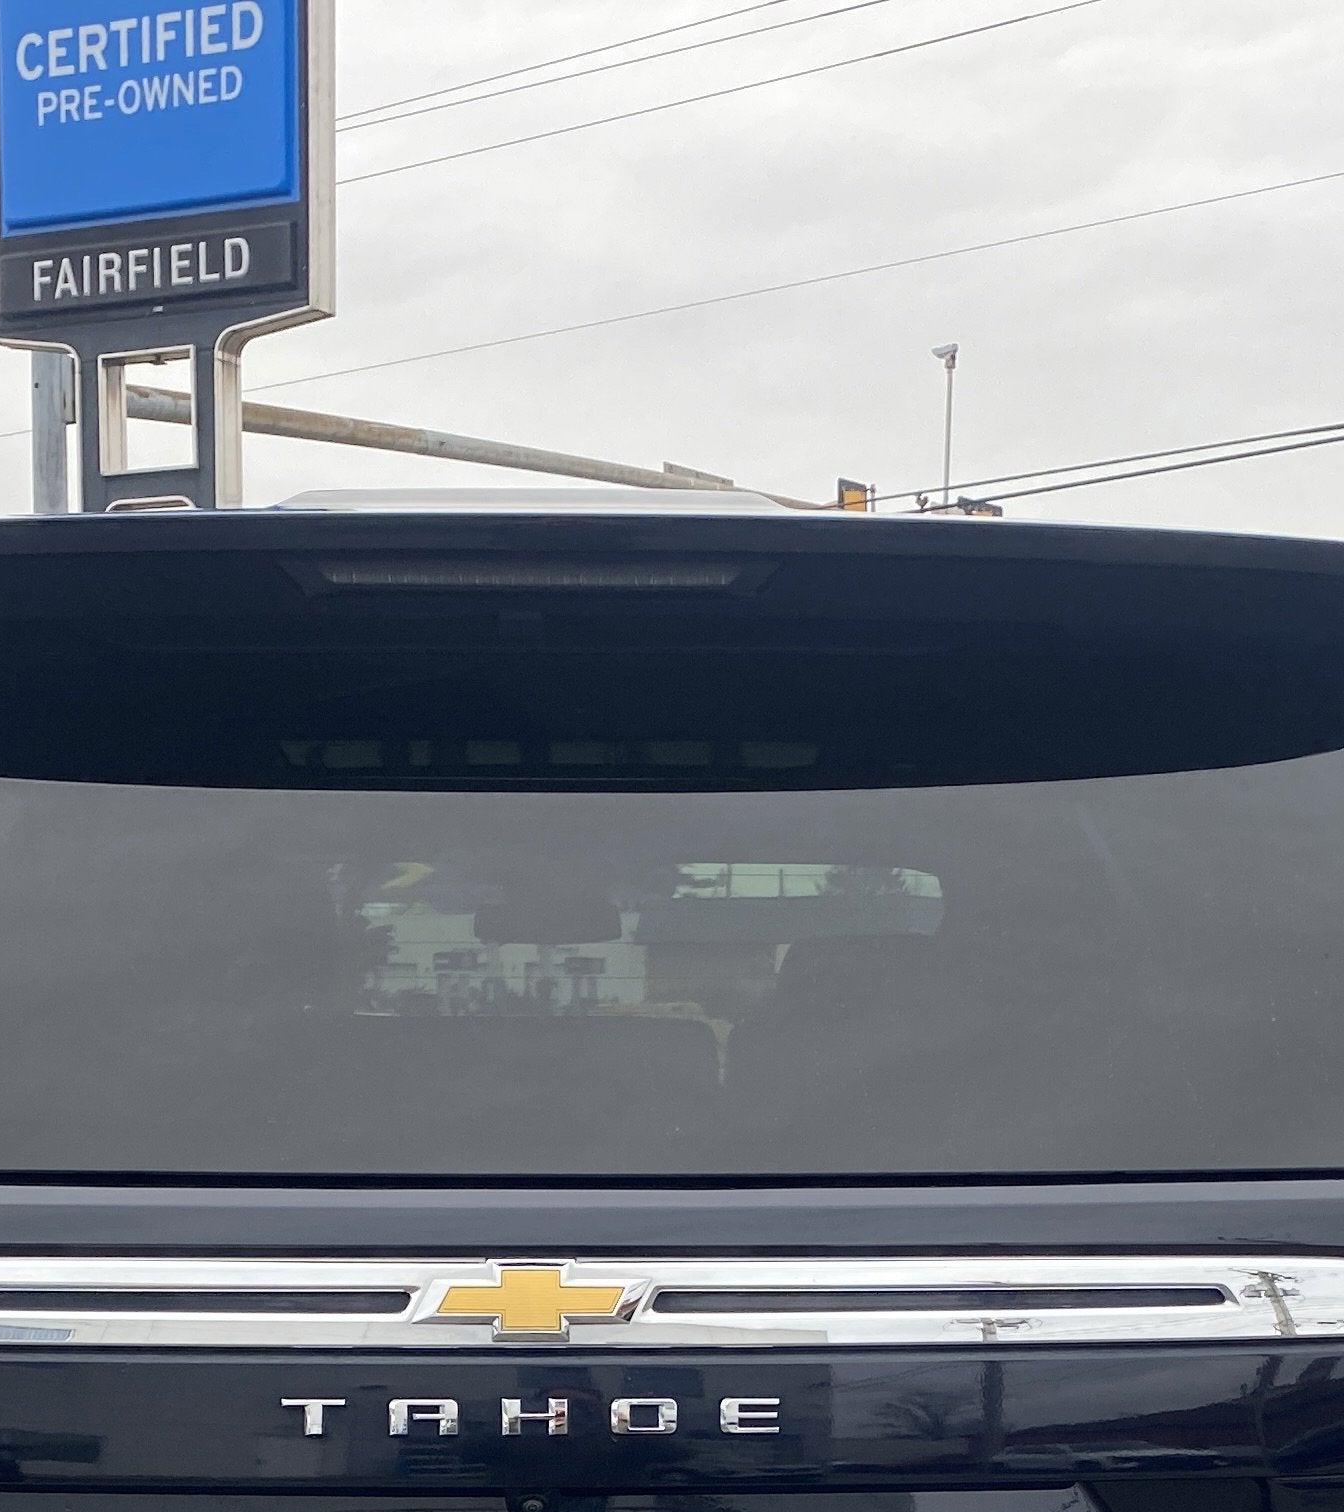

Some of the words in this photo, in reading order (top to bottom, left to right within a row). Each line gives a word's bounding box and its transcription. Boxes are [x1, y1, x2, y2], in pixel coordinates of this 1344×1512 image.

[16, 0, 264, 81] CERTIFIED
[37, 65, 243, 127] PRE-OWNED
[32, 237, 251, 301] FAIRFIELD
[281, 1398, 780, 1436] TAHOE
